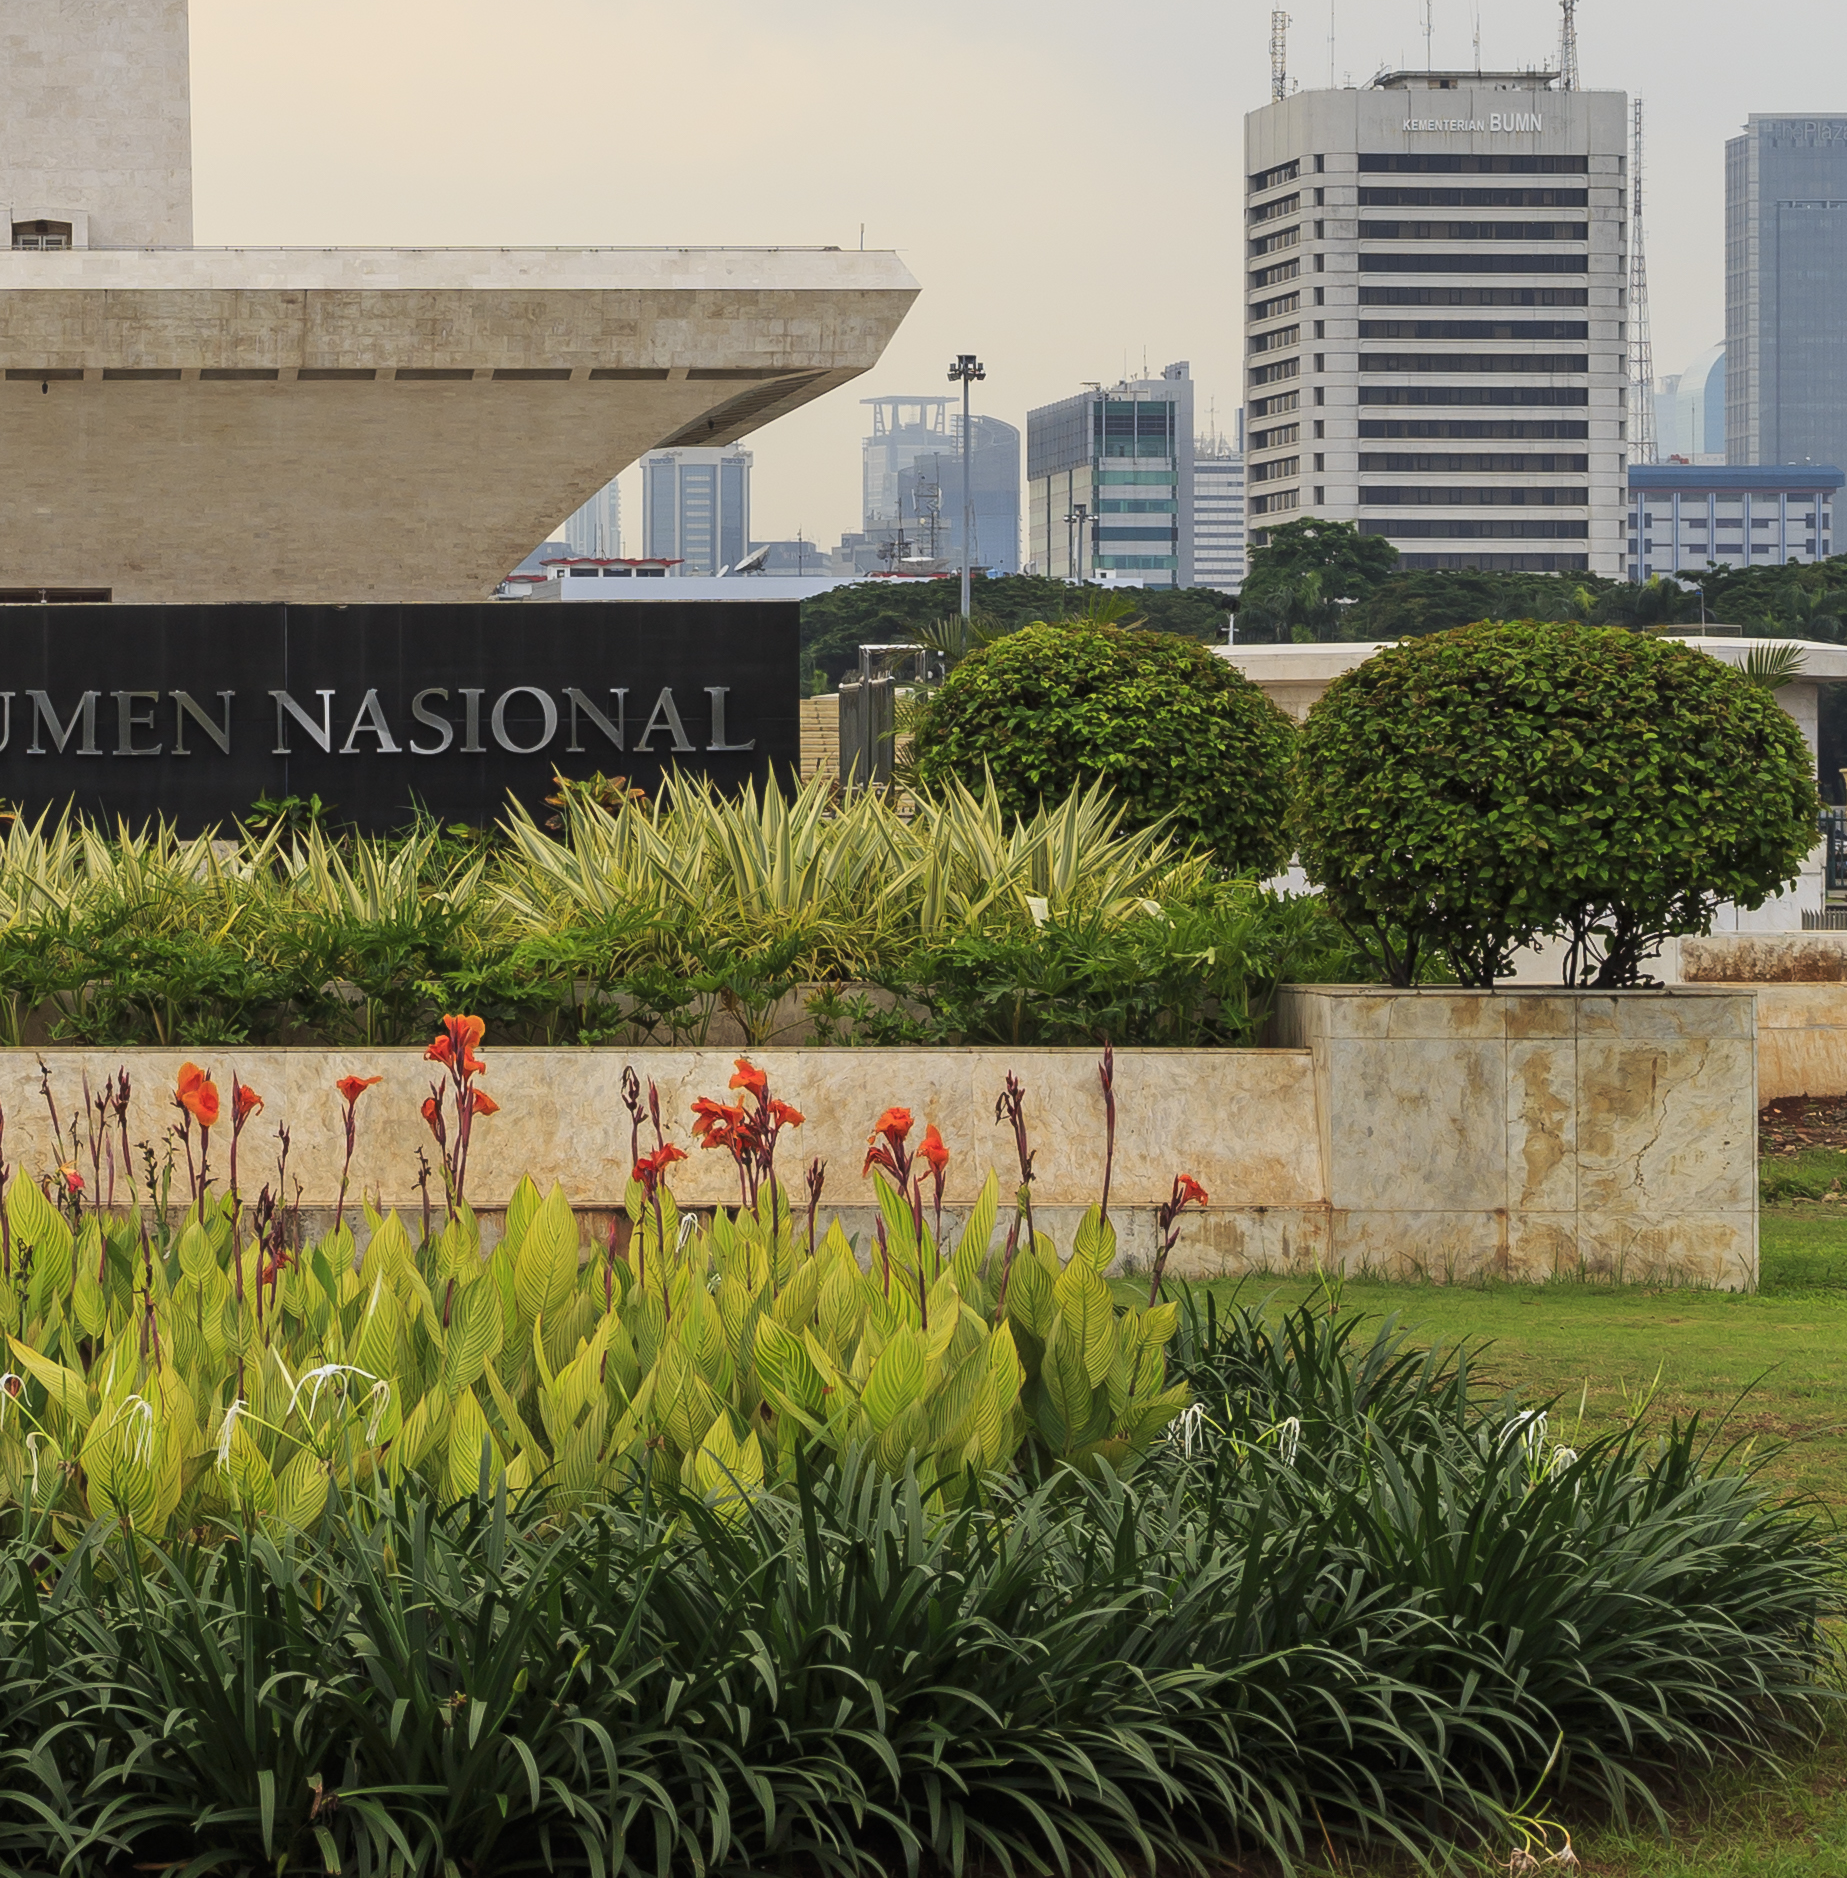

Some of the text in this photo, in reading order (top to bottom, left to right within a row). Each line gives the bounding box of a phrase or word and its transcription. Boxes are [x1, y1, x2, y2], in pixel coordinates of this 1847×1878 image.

[1402, 113, 1542, 132] KEMENTERIAN BUMN
[267, 685, 757, 755] NASIONAL
